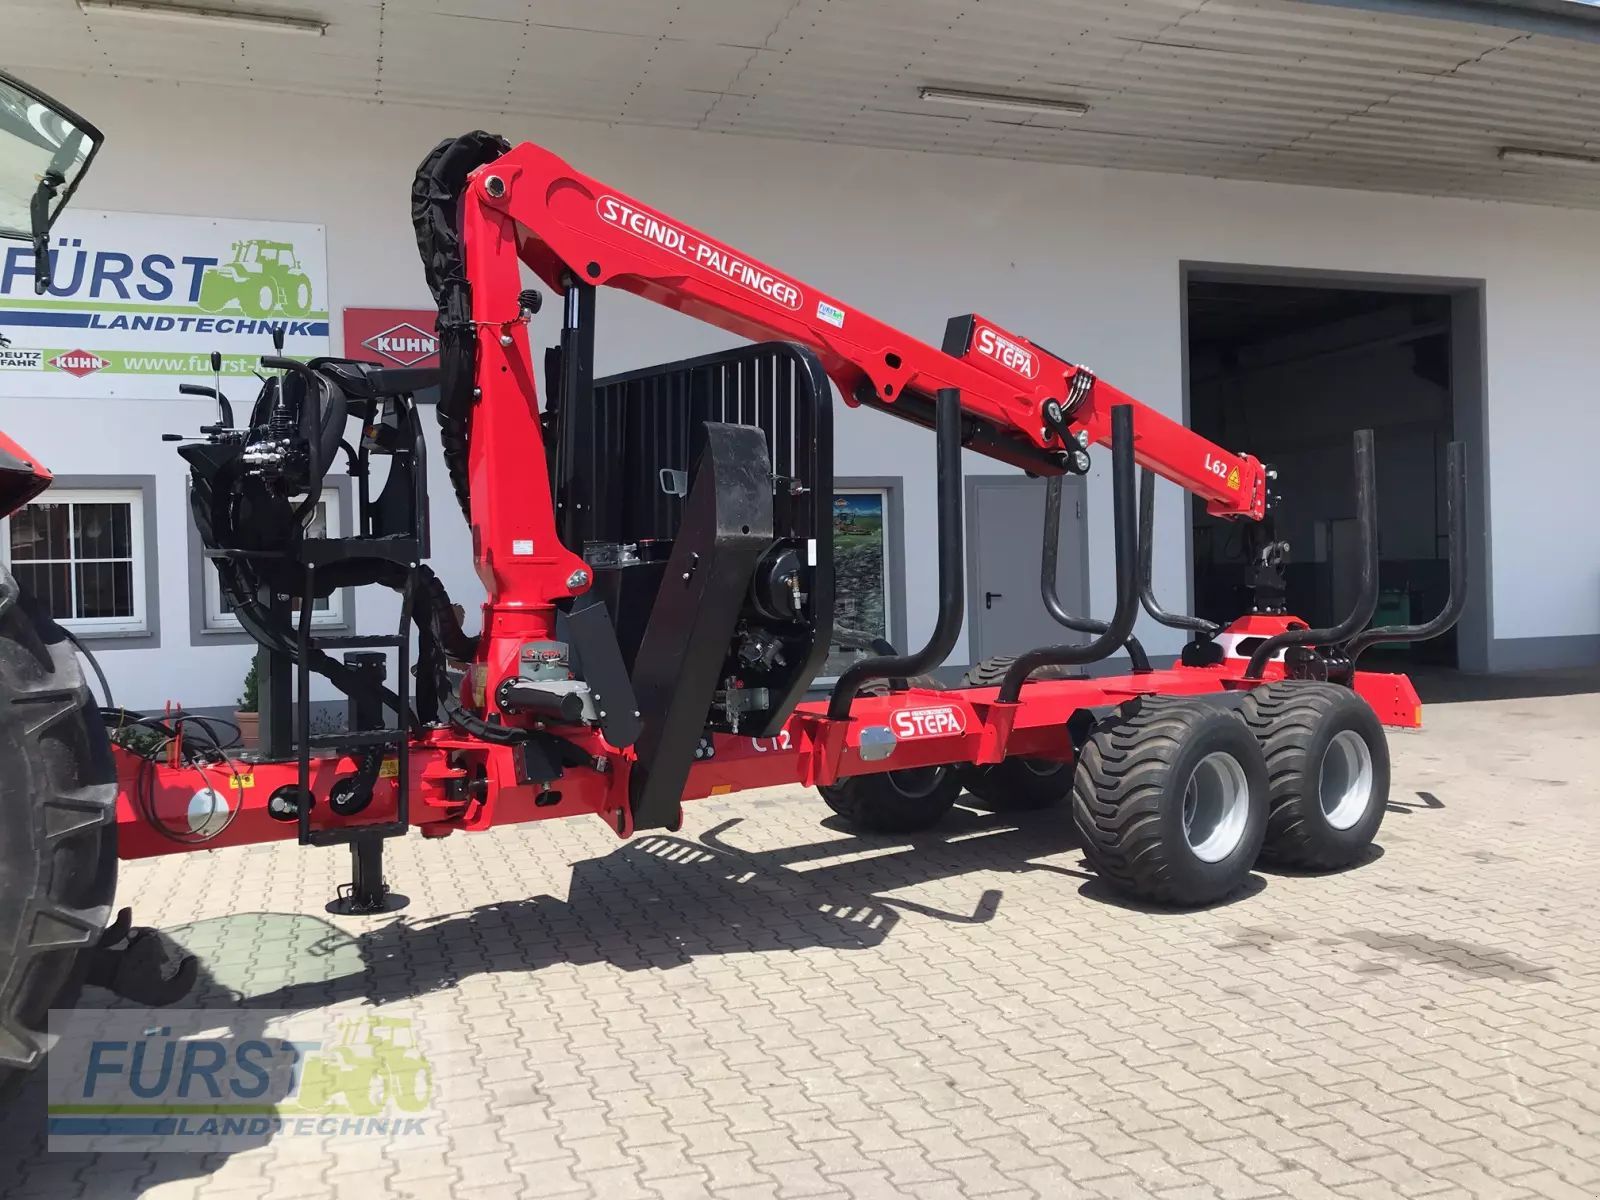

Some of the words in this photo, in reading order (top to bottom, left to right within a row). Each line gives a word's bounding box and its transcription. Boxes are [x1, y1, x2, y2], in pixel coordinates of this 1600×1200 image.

[603, 199, 798, 307] STEINDL-PALFINGER
[1, 238, 218, 302] FÜRST
[90, 314, 311, 336] LANDTECHNIK
[377, 337, 435, 353] KUHN
[979, 329, 1032, 377] STEPA
[1, 359, 37, 367] FAHR
[56, 356, 103, 369] KUHN
[1205, 453, 1227, 478] L62
[896, 711, 961, 737] STEPA
